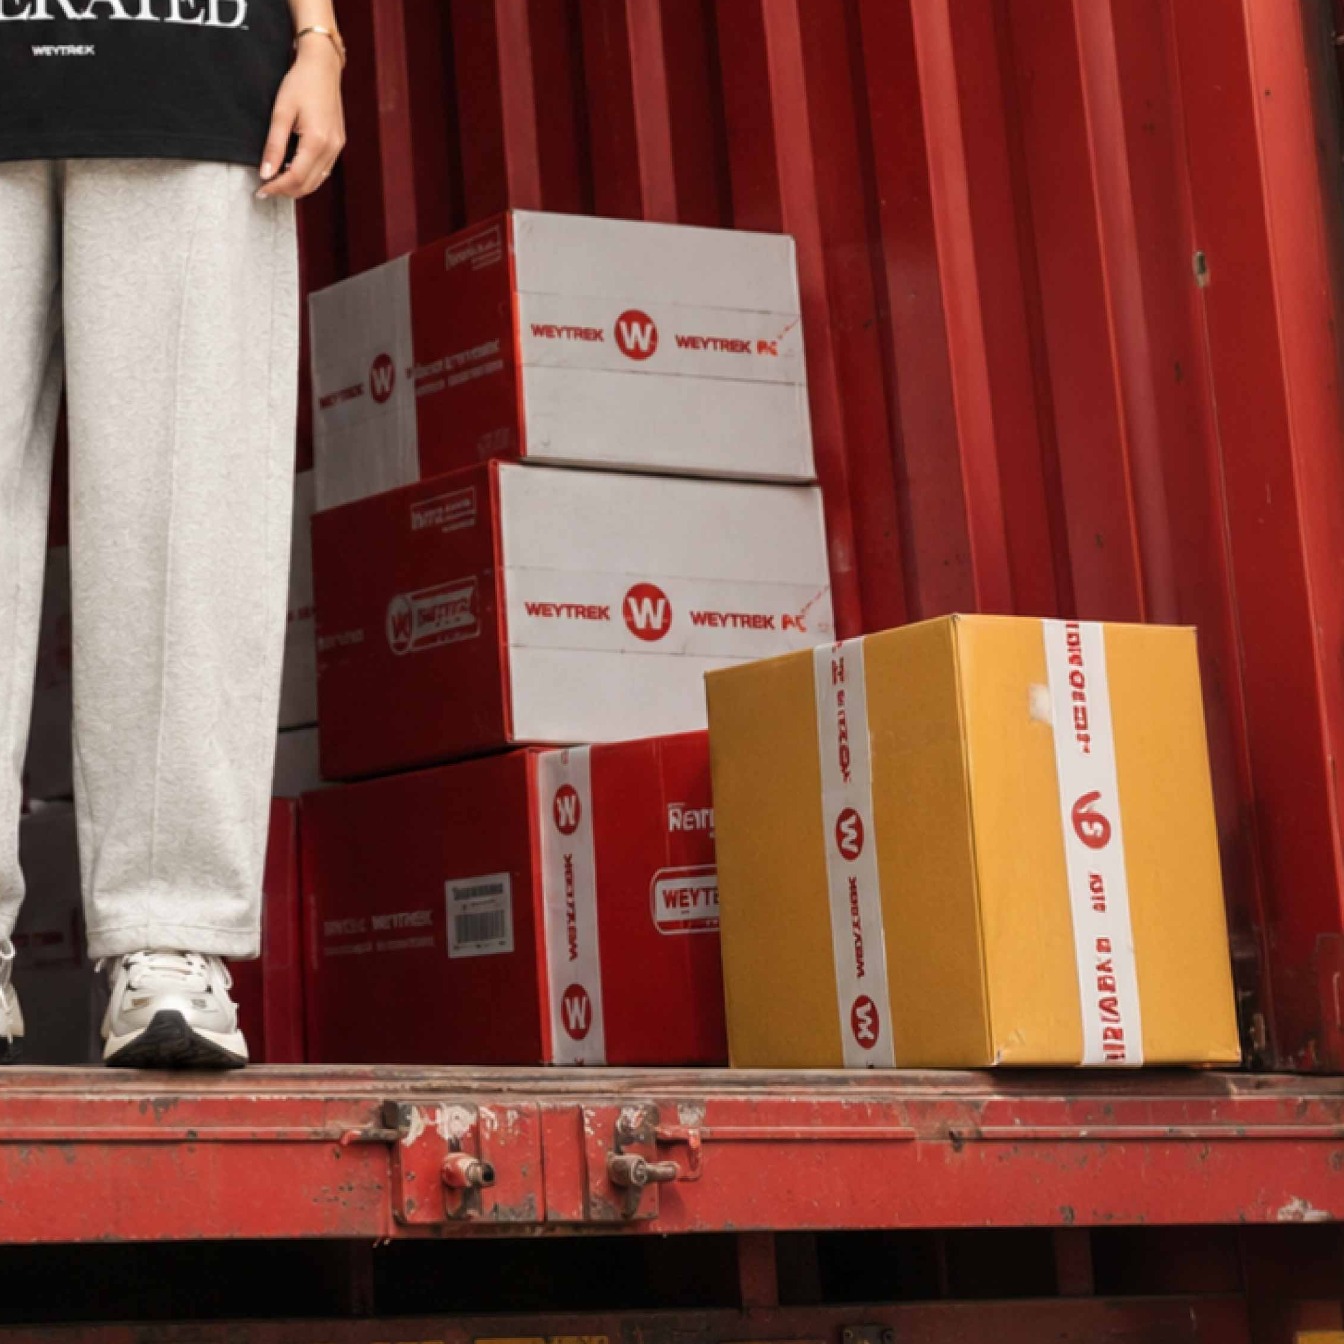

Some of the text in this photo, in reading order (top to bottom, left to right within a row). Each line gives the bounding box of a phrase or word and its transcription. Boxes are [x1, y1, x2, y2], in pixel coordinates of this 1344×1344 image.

[531, 323, 604, 342] WEYTREK
[619, 320, 653, 353] W
[674, 333, 752, 354] WEYTREK
[524, 601, 610, 622] WEYTREK
[627, 596, 666, 631] W
[689, 610, 775, 631] WEYTREK
